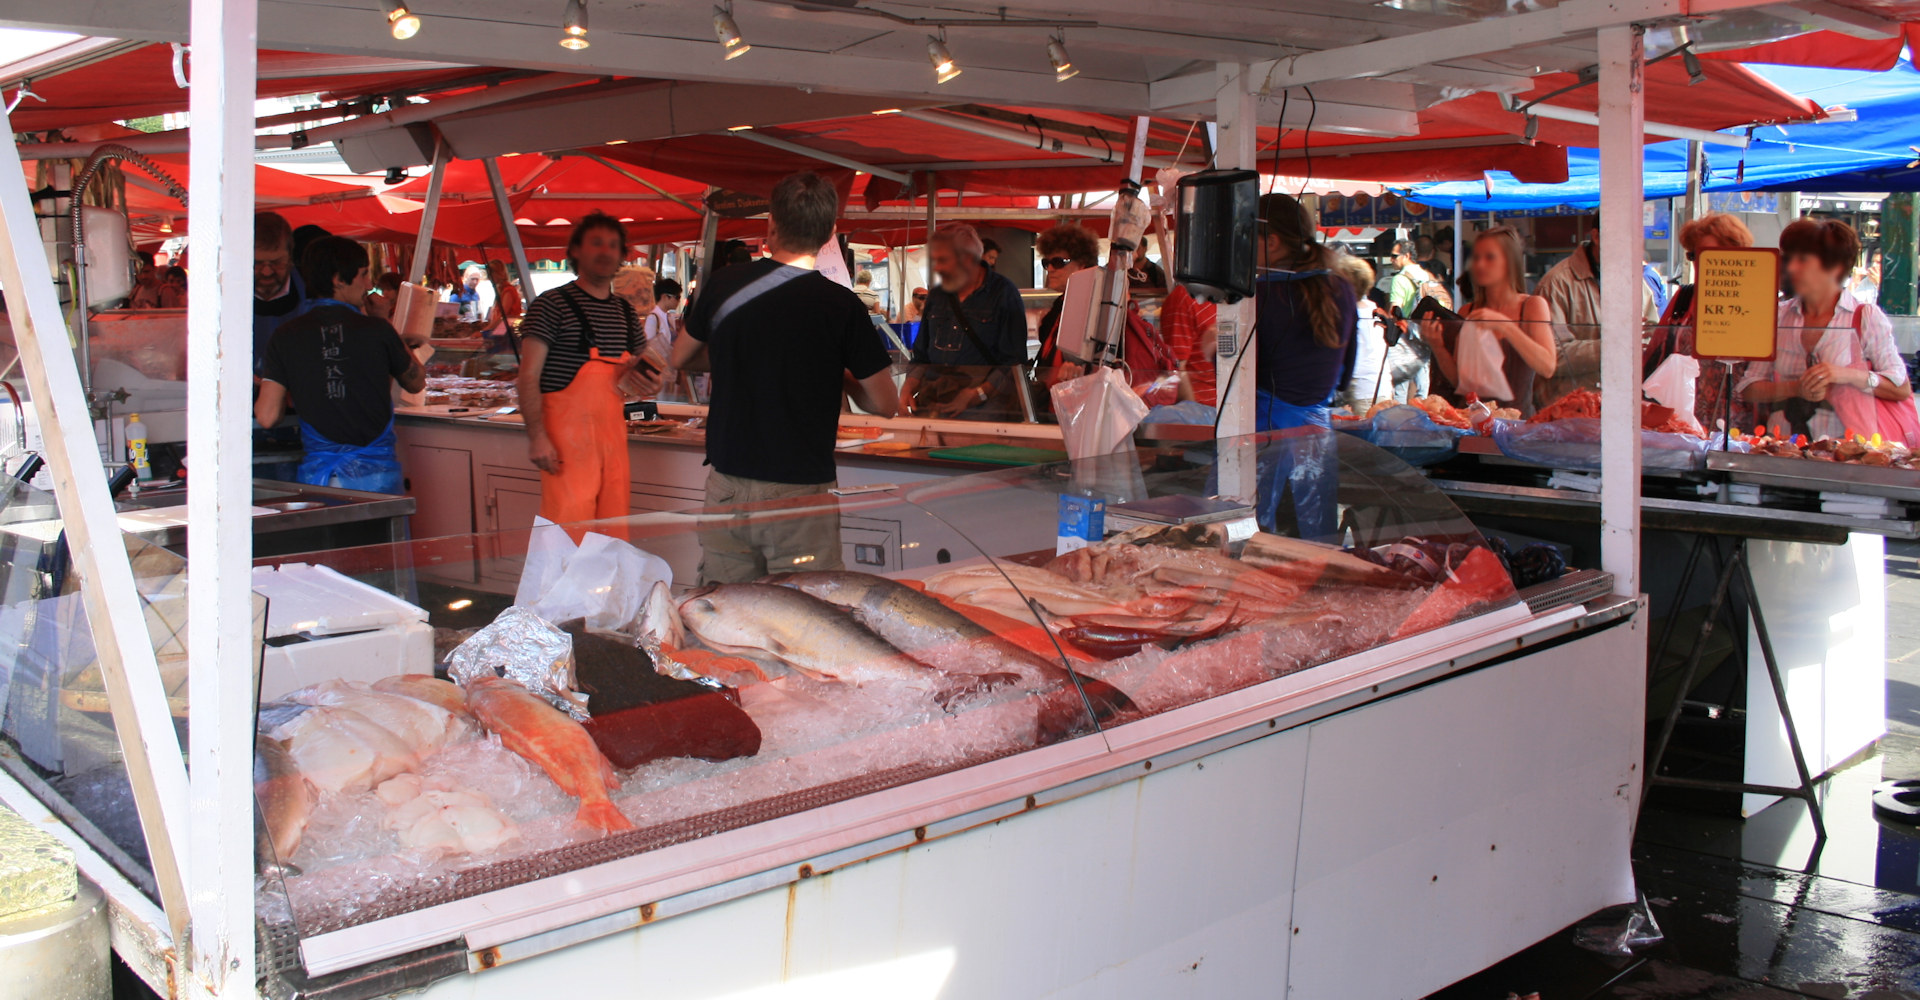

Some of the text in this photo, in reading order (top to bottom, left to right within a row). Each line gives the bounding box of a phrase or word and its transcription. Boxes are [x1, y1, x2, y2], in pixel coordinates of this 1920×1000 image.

[1706, 258, 1757, 267] NYKOKTE
[1705, 268, 1745, 277] FERSKE
[1705, 279, 1741, 287] FJORD-
[1704, 289, 1740, 298] REKER
[1704, 304, 1750, 316] KR 79,-
